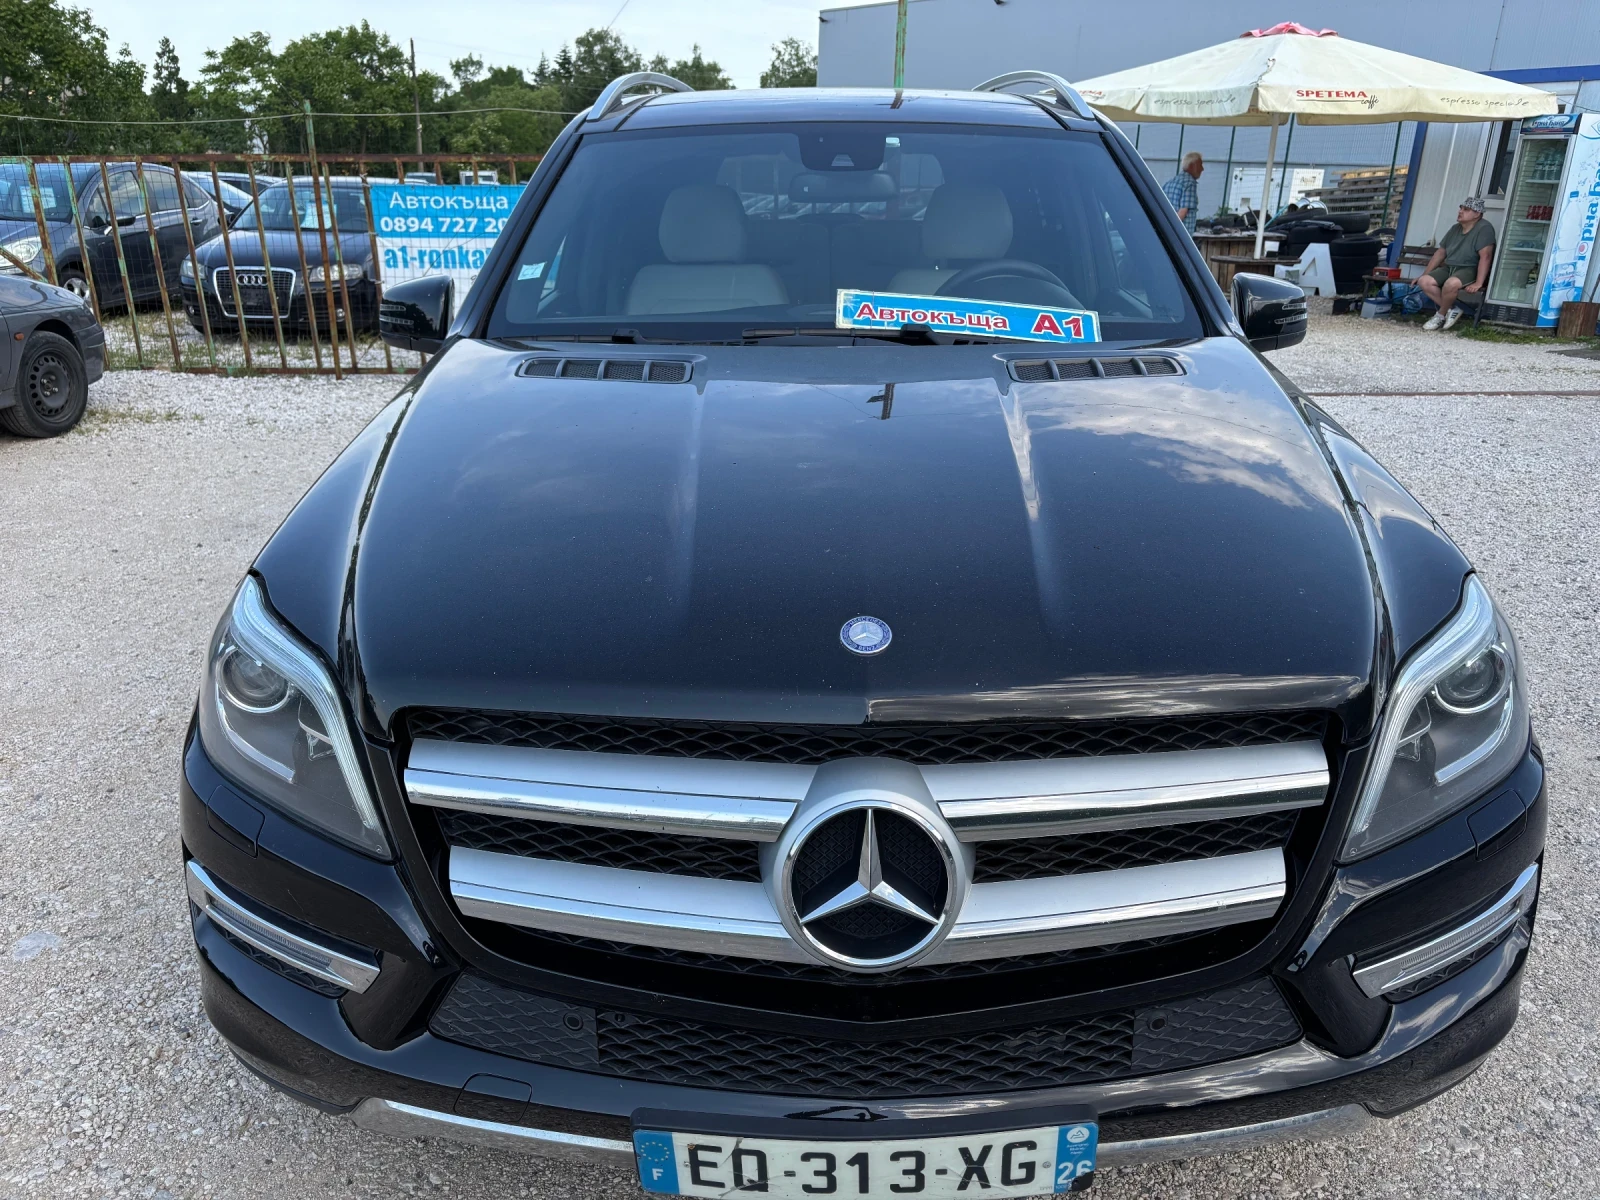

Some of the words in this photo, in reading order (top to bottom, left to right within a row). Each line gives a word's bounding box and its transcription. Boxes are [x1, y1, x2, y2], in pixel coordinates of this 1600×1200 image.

[1296, 90, 1368, 98] SPETEMA
[1440, 96, 1480, 107] espresso
[1484, 98, 1529, 108] speciale
[389, 191, 509, 213] Автокъща
[380, 217, 434, 233] 0894
[438, 217, 479, 233] 727
[384, 245, 492, 270] a1-ronka
[855, 302, 1010, 331] Автокъща
[651, 1167, 664, 1181] F
[688, 1140, 1038, 1194] EQ-313-XG
